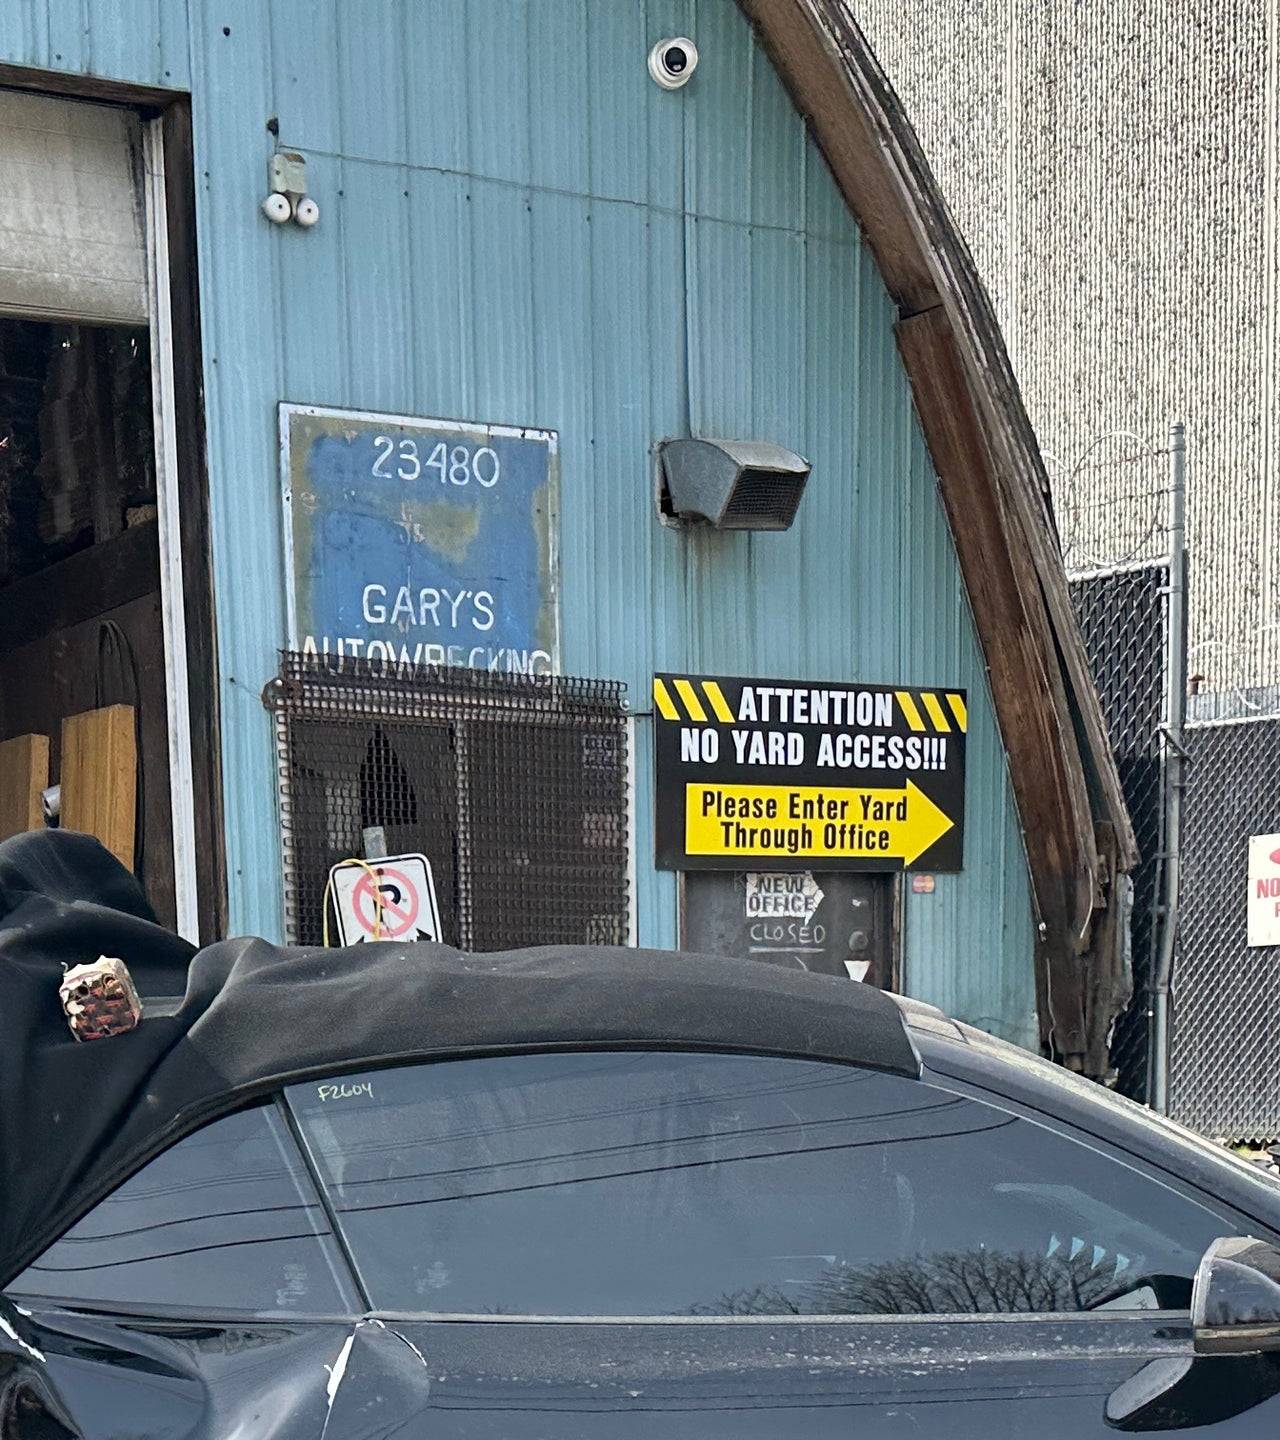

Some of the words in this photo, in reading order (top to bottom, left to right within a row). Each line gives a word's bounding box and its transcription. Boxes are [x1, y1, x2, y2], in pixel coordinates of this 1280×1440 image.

[371, 436, 500, 488] 23480
[362, 584, 495, 631] GARY'S
[738, 686, 893, 727] ATTENTION
[680, 727, 719, 764] NO
[731, 730, 805, 766] YARD
[817, 733, 947, 770] ACCESS!!!
[702, 790, 777, 819] Please
[789, 793, 849, 820] Enter
[859, 795, 907, 821] Yard
[720, 821, 813, 854] Through
[824, 823, 889, 850] Office
[758, 876, 804, 894] NEW
[1256, 878, 1280, 899] NO
[749, 893, 815, 913] OFFICE
[749, 923, 826, 945] CLOSED
[317, 1082, 374, 1102] F2604
